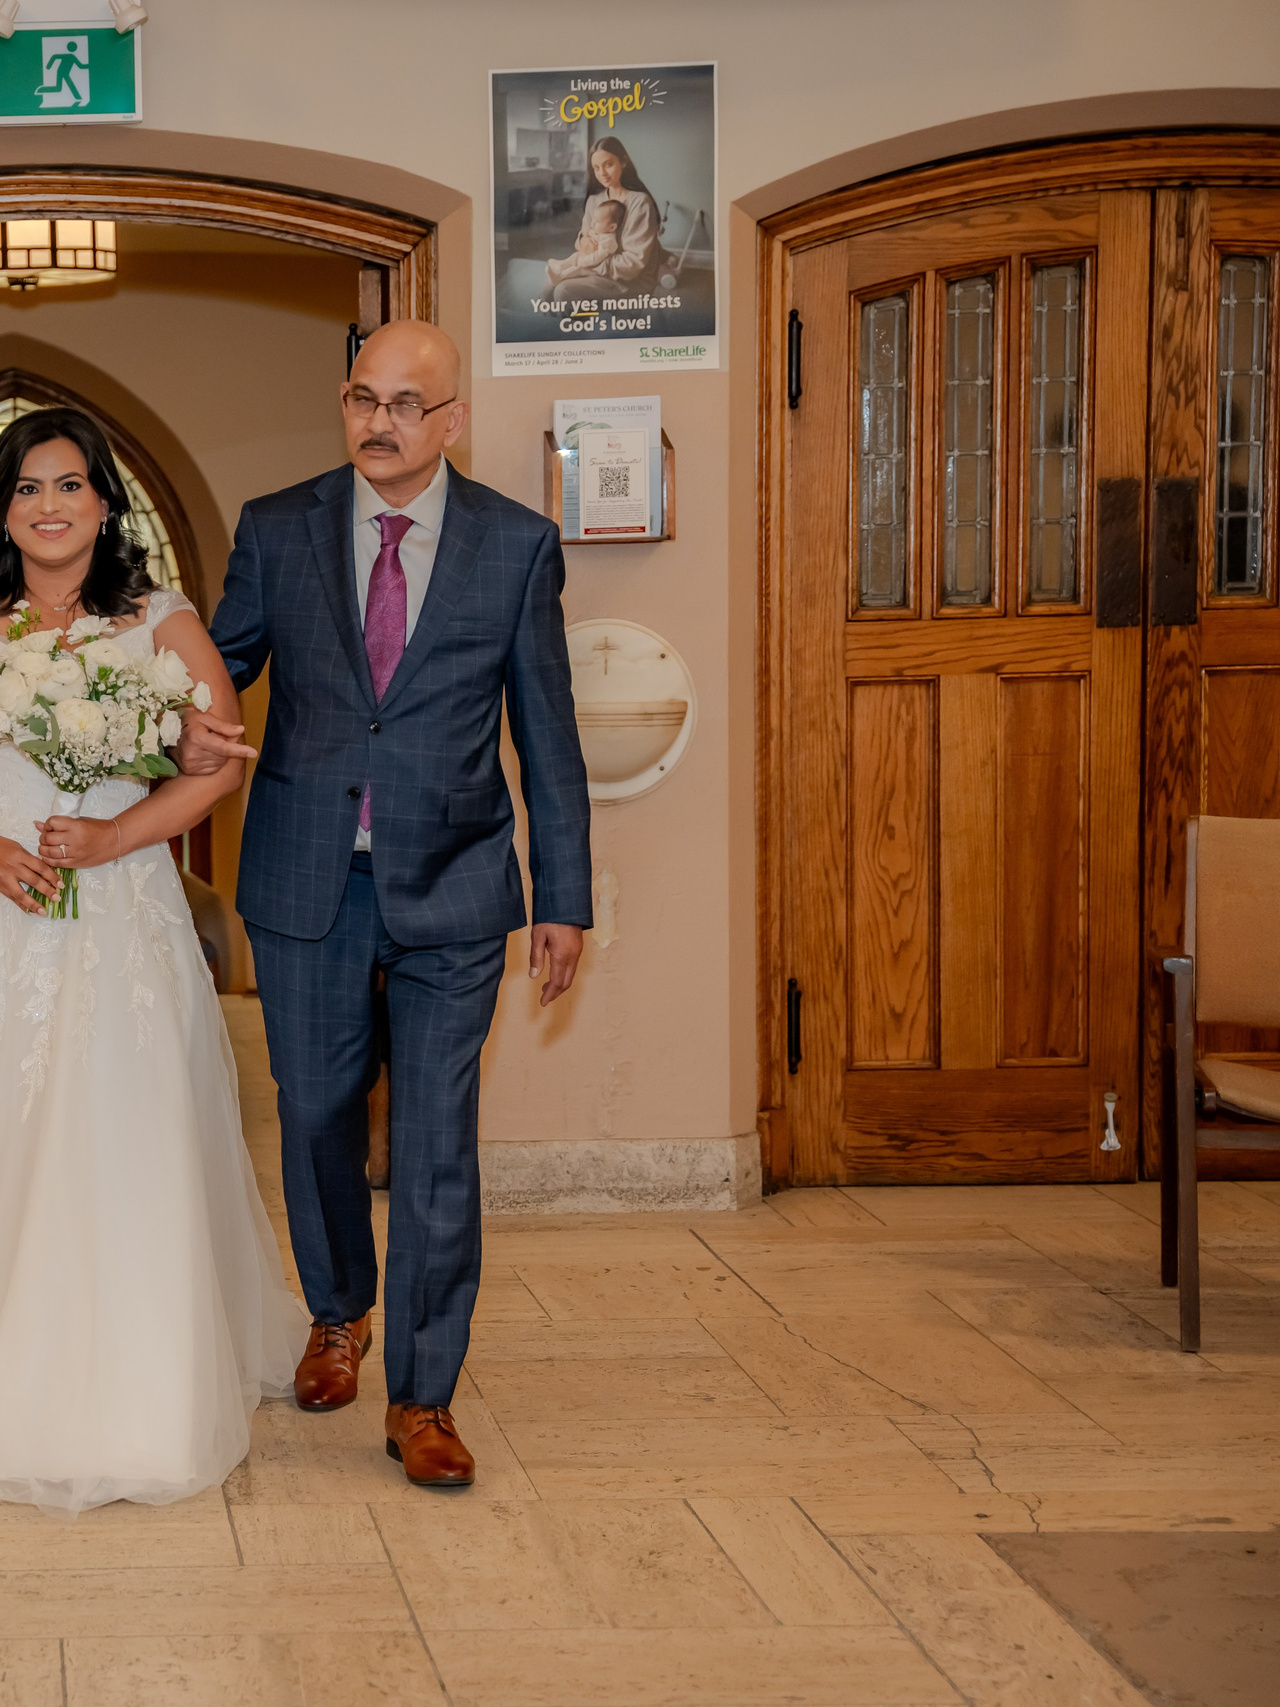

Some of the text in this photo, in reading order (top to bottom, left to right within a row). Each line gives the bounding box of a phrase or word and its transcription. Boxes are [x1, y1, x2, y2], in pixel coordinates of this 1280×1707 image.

[570, 78, 631, 93] Living the
[560, 82, 646, 128] Gospel
[530, 295, 681, 316] Your yes manifests
[559, 315, 652, 332] God's love!
[652, 345, 706, 357] ShareLife
